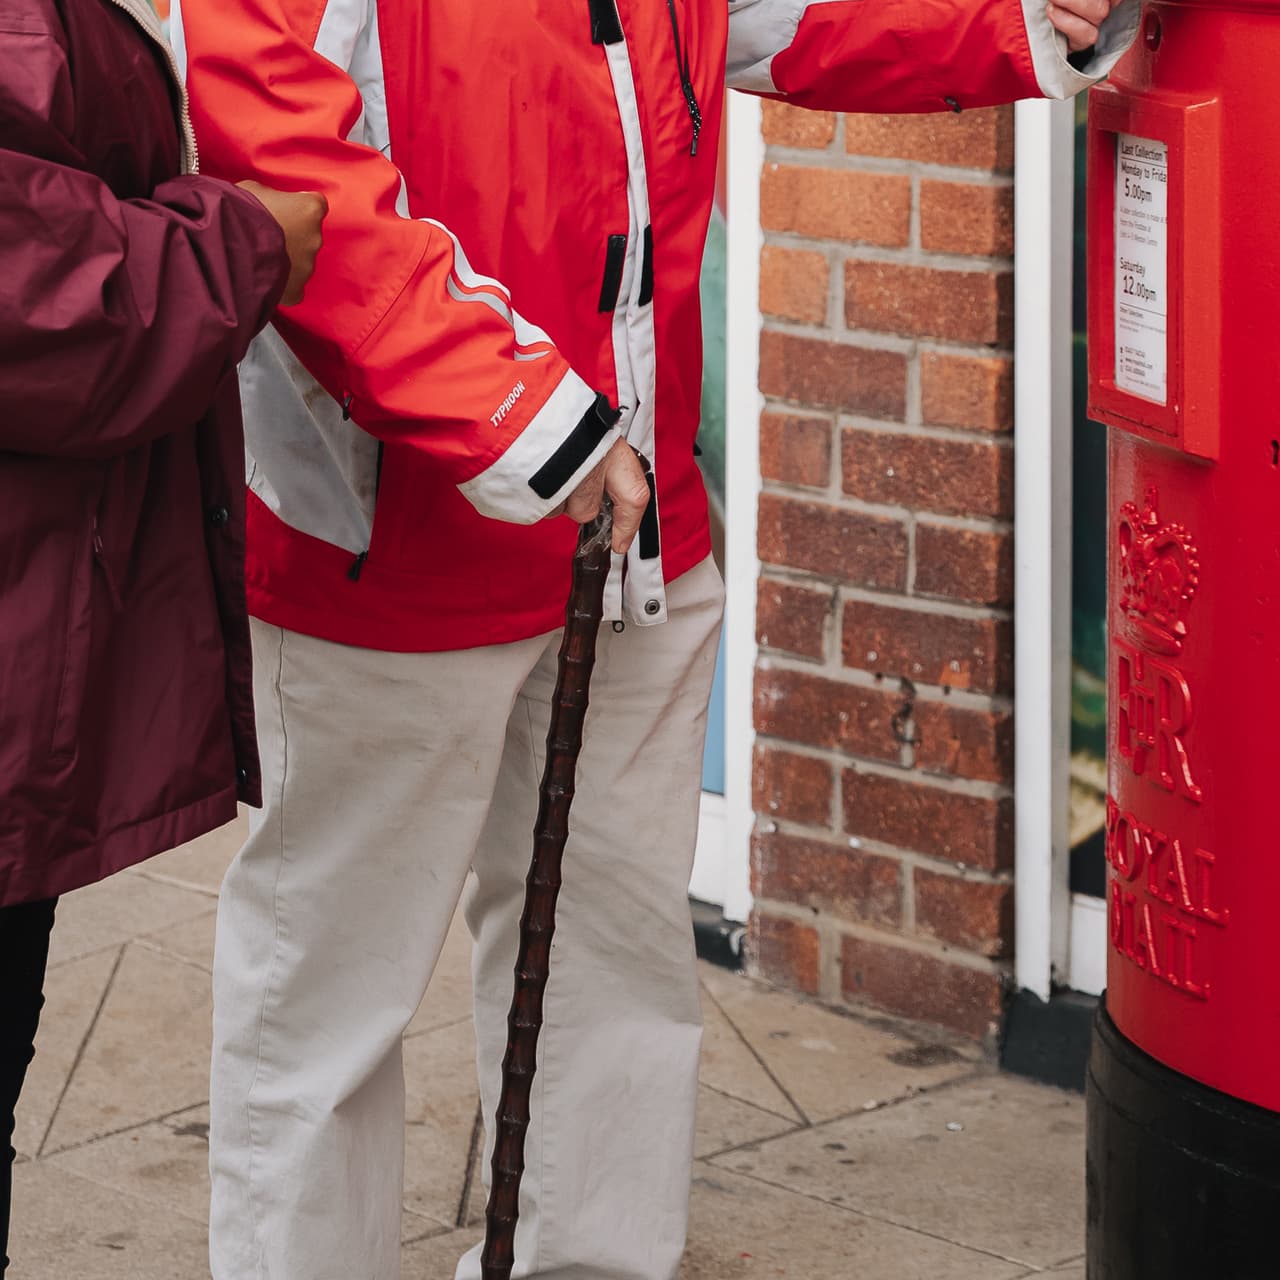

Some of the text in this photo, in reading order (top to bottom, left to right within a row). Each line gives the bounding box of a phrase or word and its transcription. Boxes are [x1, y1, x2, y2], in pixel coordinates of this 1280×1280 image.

[1152, 167, 1167, 183] Frida
[1125, 178, 1152, 204] 5.00pm
[1120, 256, 1146, 278] Saturday
[1123, 275, 1157, 303] 12.00pm
[489, 380, 526, 428] TYPHOON
